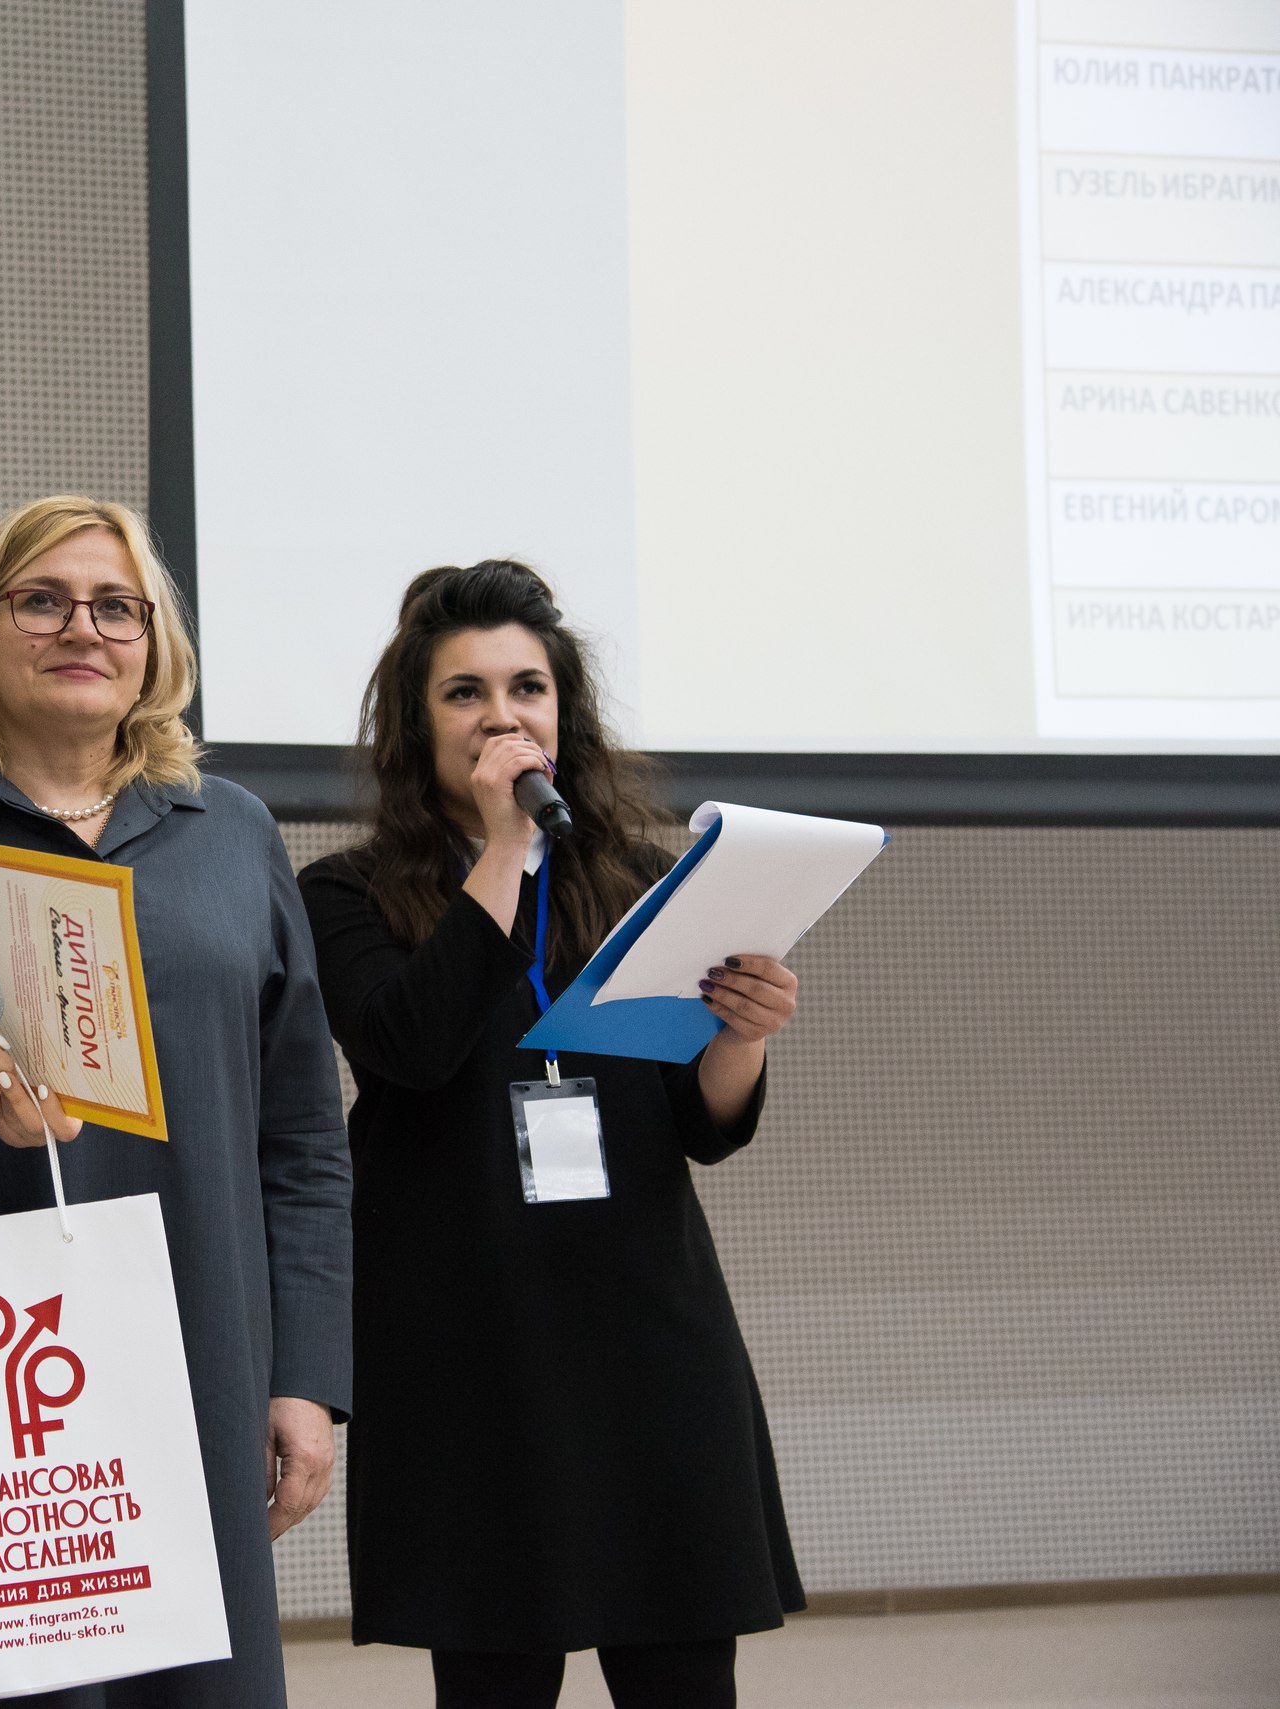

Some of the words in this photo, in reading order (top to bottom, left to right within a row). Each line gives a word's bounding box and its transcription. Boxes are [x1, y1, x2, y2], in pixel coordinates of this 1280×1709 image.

[1054, 58, 1139, 87] ЮЛИЯ
[1149, 62, 1280, 94] ПАНКРАТ
[1055, 169, 1156, 198] ГУЗЕЛЬ
[1058, 277, 1244, 314] АЛЕКСАНДРА
[1060, 385, 1157, 414] АРИНА
[1063, 486, 1188, 522] ЕВГЕНИЙ
[1067, 603, 1165, 630] ИРИНА
[1173, 604, 1280, 631] КОСТАР
[62, 913, 101, 1070] ДИПЛОМ
[37, 1581, 72, 1600] ДЛЯ
[80, 1571, 145, 1591] ЖИЗНИ
